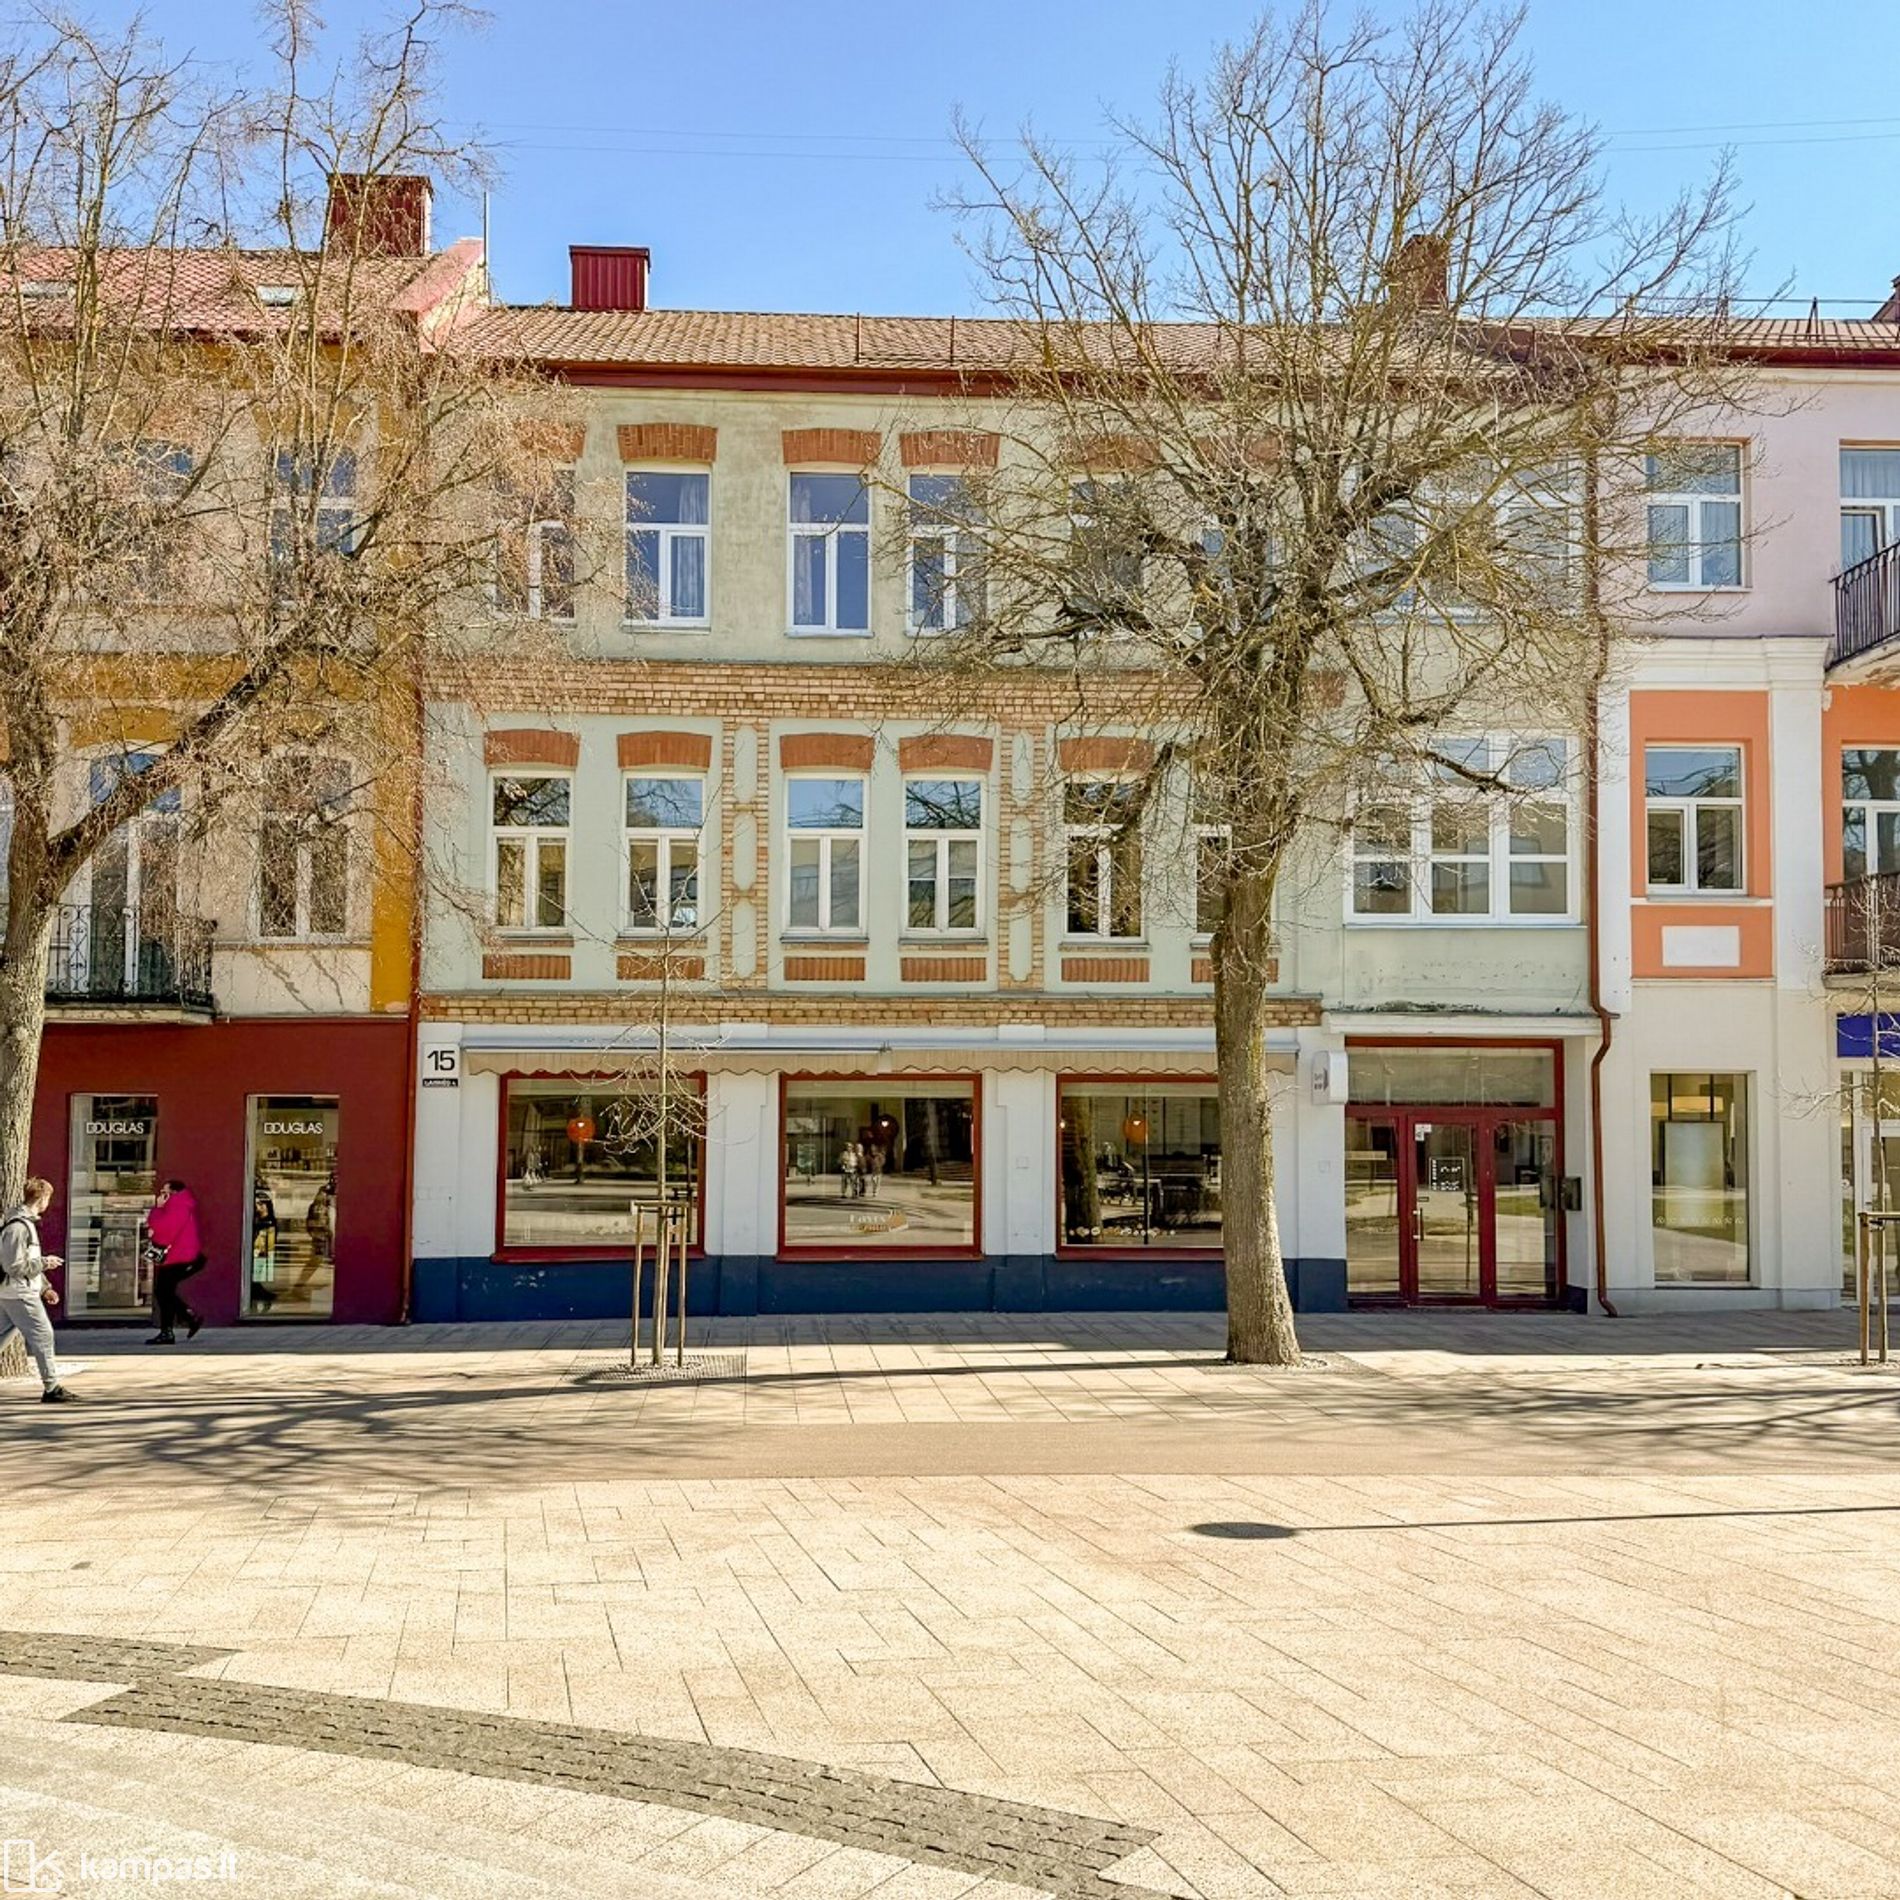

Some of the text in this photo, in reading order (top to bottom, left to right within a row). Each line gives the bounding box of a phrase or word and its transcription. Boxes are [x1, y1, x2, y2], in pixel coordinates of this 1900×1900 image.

[427, 1050, 455, 1071] 15
[86, 1122, 144, 1134] DOUGLAS
[263, 1122, 324, 1134] DOUGLAS
